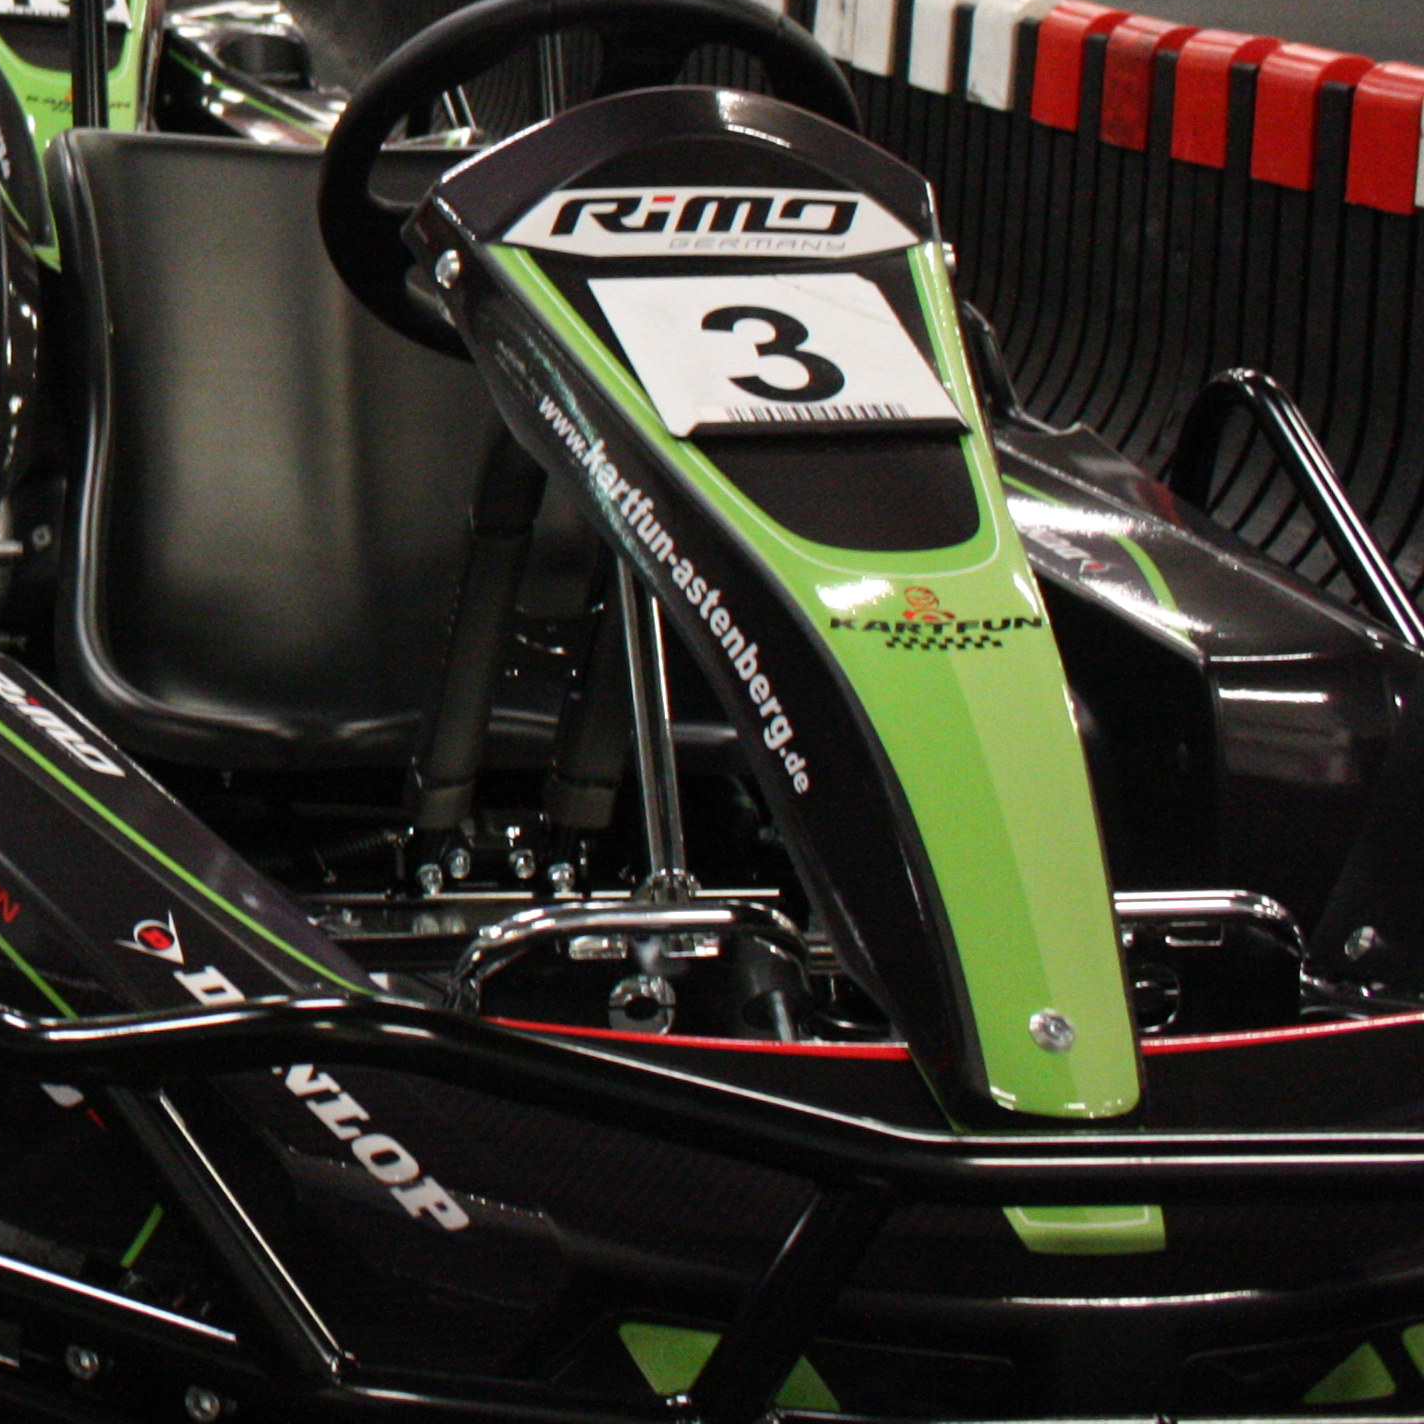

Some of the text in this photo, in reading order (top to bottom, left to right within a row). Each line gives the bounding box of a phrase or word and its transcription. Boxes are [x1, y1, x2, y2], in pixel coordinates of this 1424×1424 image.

[666, 234, 849, 254] GERMANY
[700, 305, 846, 403] 3
[538, 395, 812, 795] www.kartfun-astenberg.de
[829, 615, 1042, 636] KARTFUN
